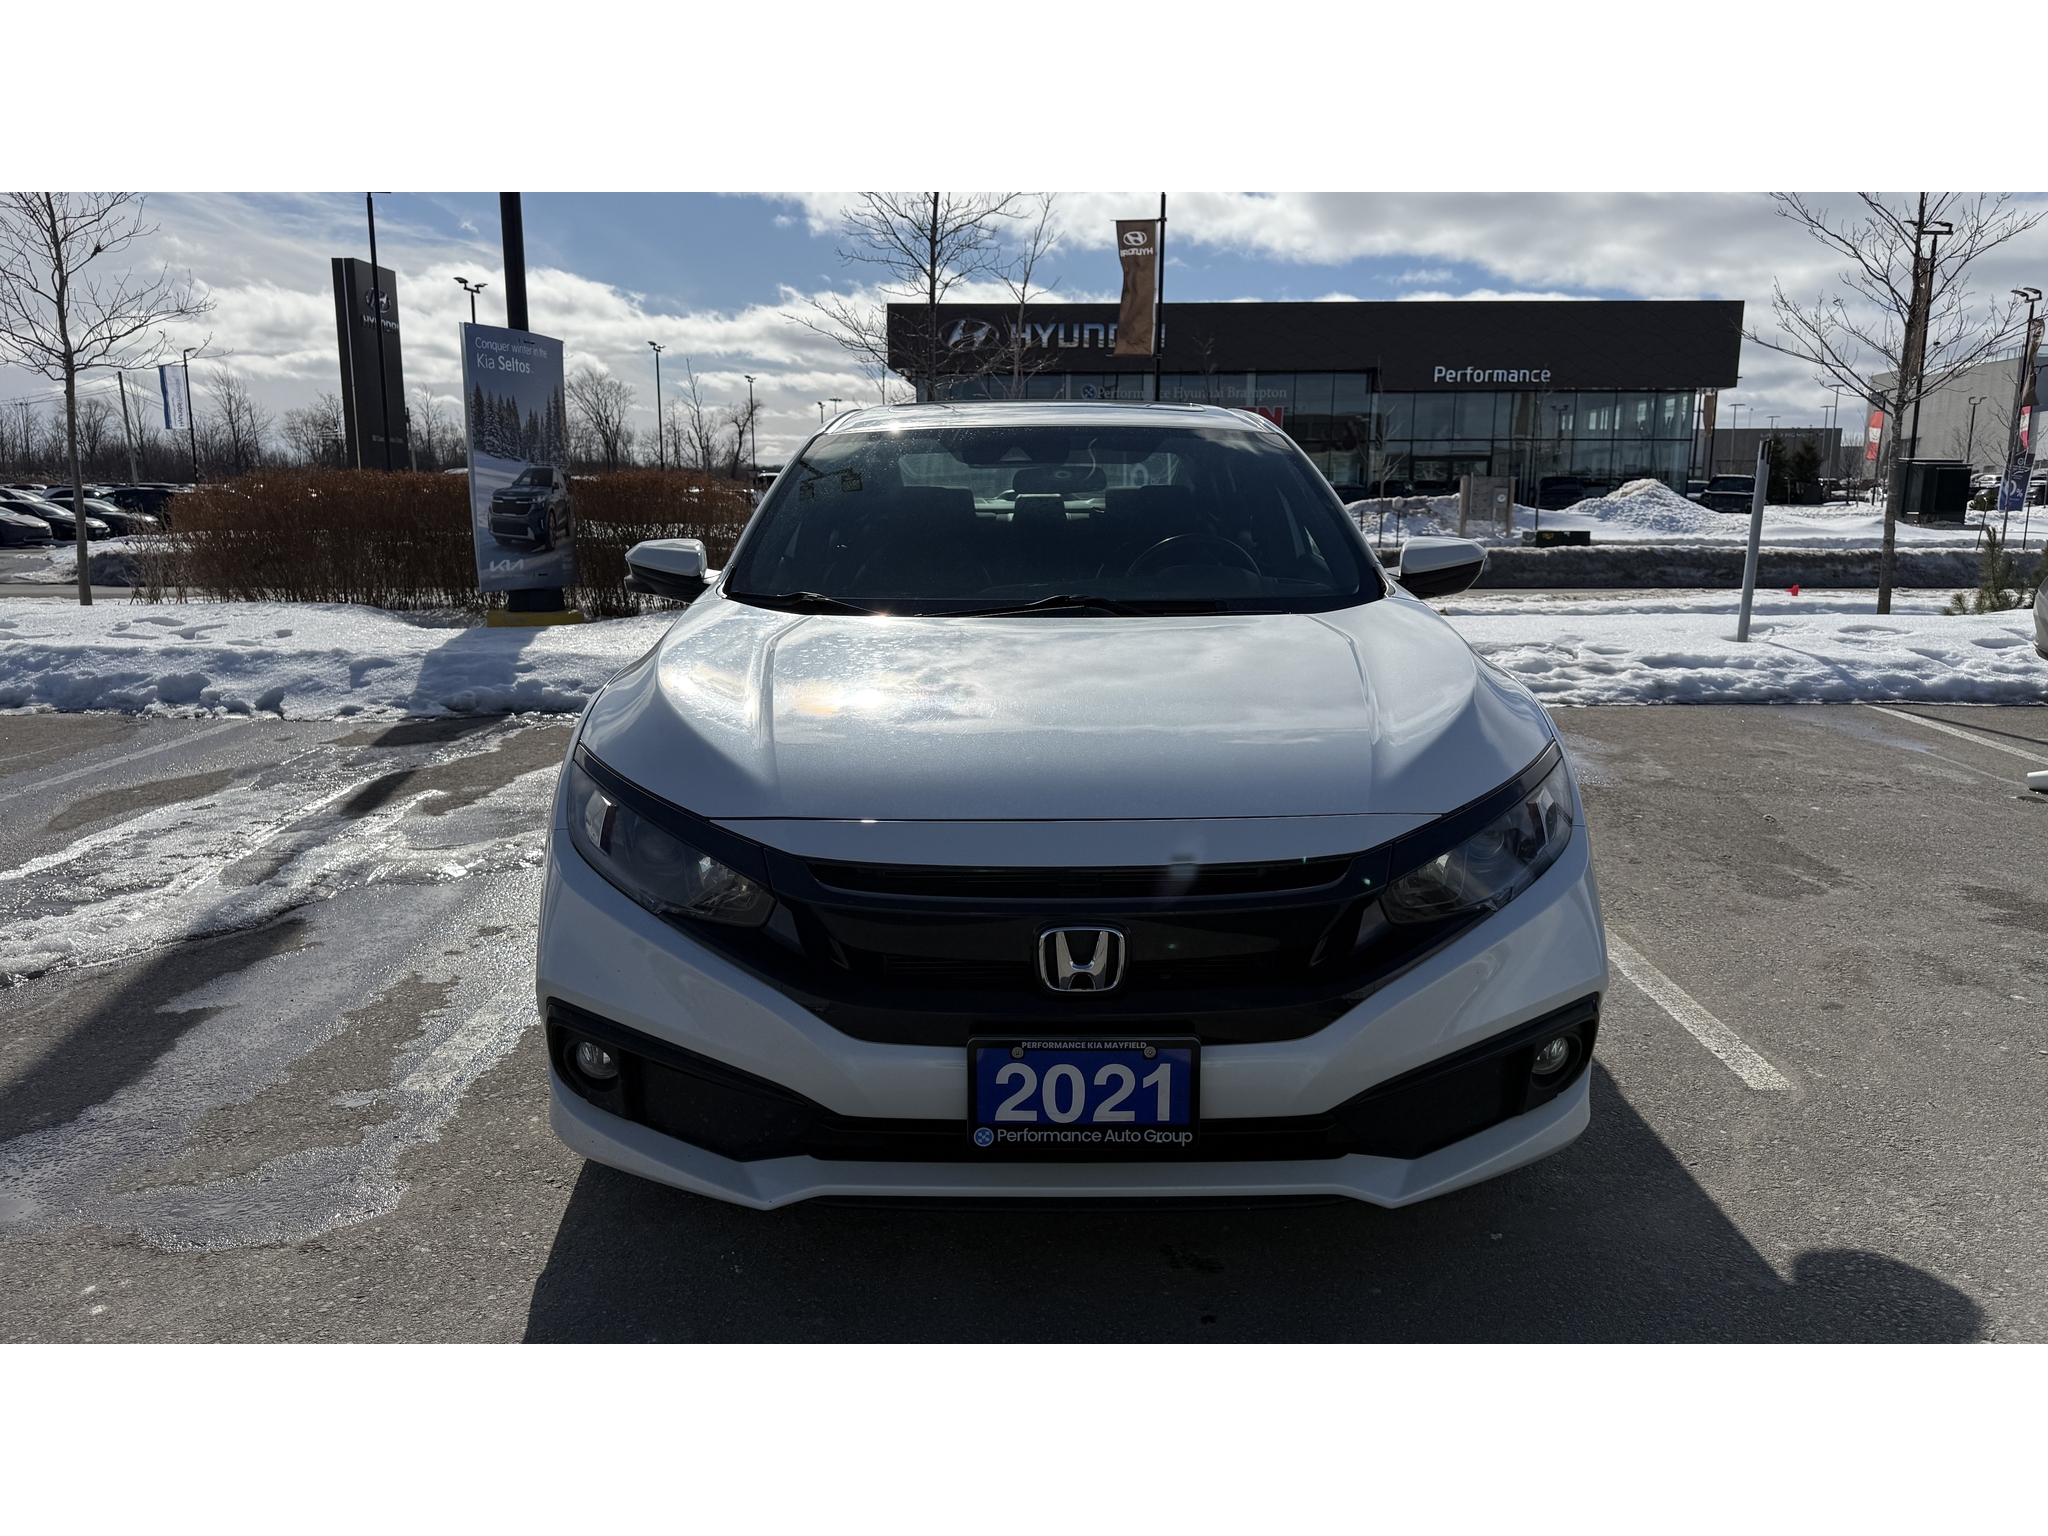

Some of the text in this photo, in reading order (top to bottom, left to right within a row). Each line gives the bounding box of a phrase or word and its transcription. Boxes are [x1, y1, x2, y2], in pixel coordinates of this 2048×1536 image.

[475, 336, 510, 353] Conquer
[511, 343, 532, 356] winter
[476, 352, 531, 374] Kia Seltos
[1433, 365, 1552, 383] Performance
[1021, 1041, 1147, 1049] PERFORMANCE KIA MAYFIELD
[994, 1062, 1171, 1124] 2021
[997, 1127, 1193, 1147] Performance Auto Group
